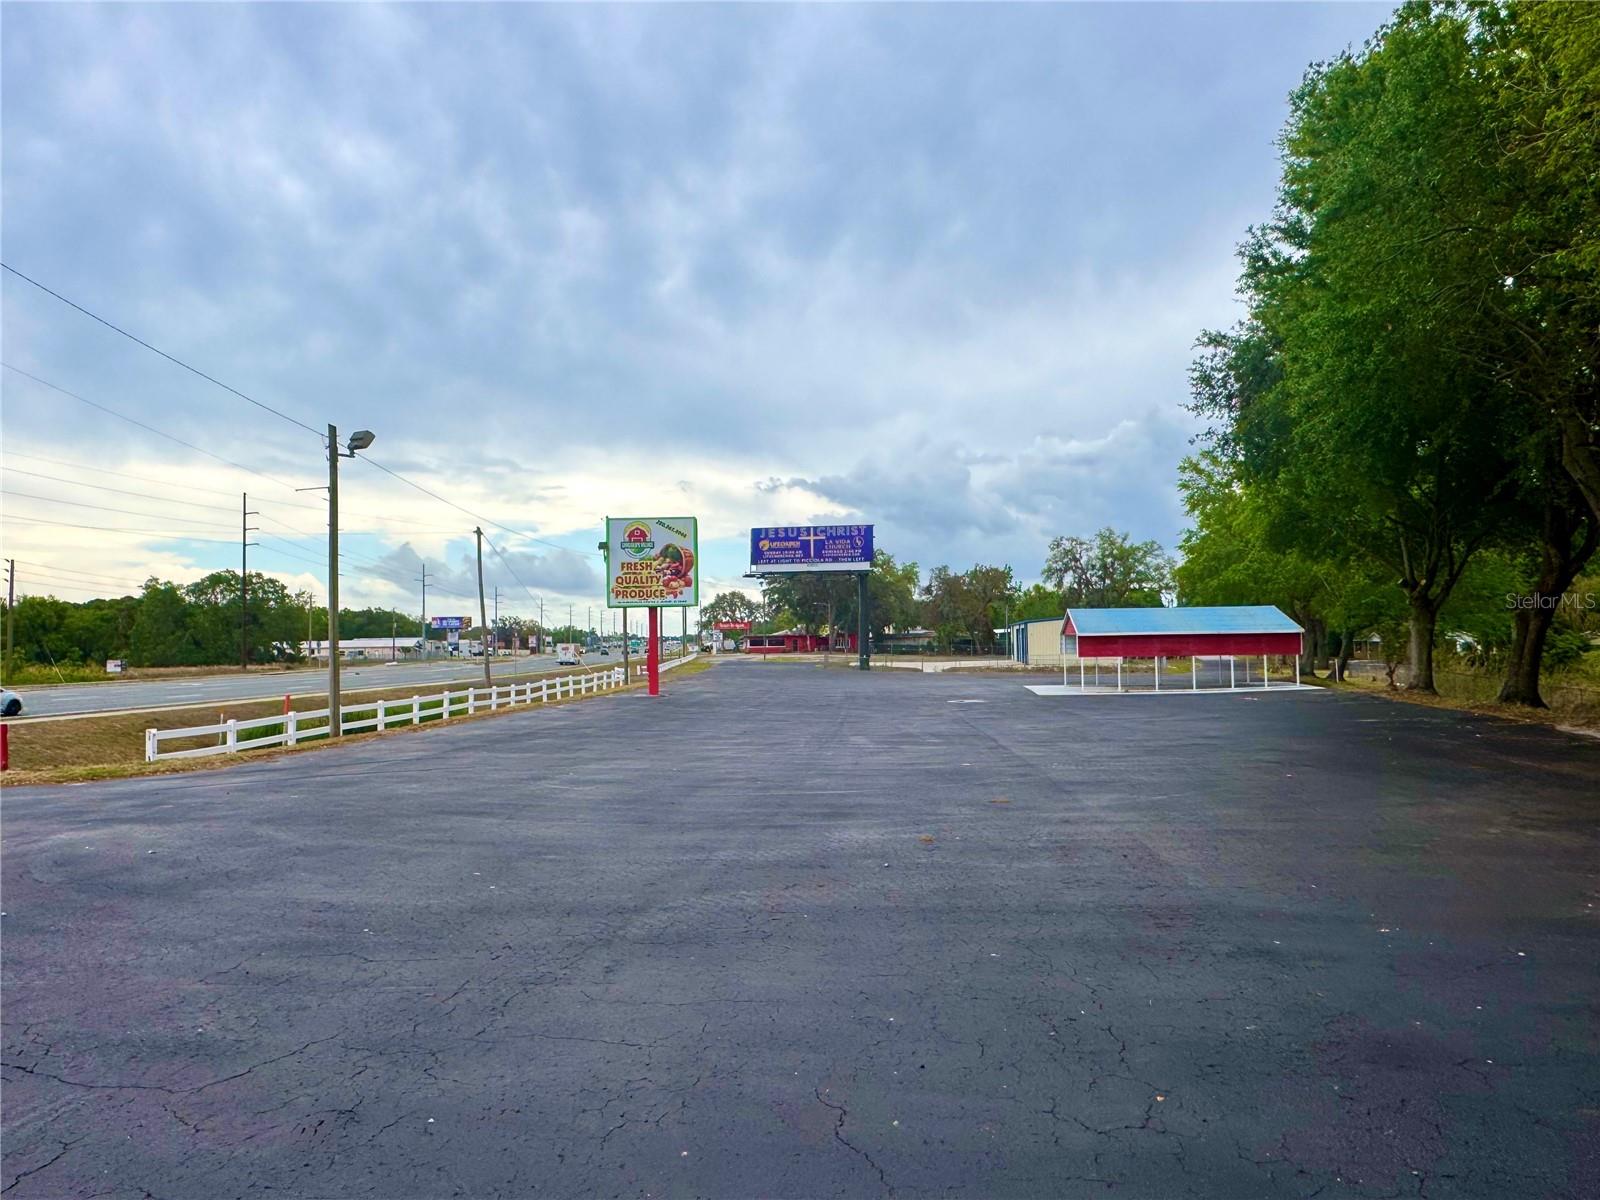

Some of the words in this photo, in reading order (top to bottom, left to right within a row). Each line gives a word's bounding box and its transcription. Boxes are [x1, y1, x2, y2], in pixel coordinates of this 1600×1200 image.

[760, 528, 807, 538] JESUS
[816, 526, 866, 537] CHRIST
[621, 562, 653, 571] FRESH
[615, 576, 661, 585] QUALITY
[615, 589, 666, 599] PRODUCE
